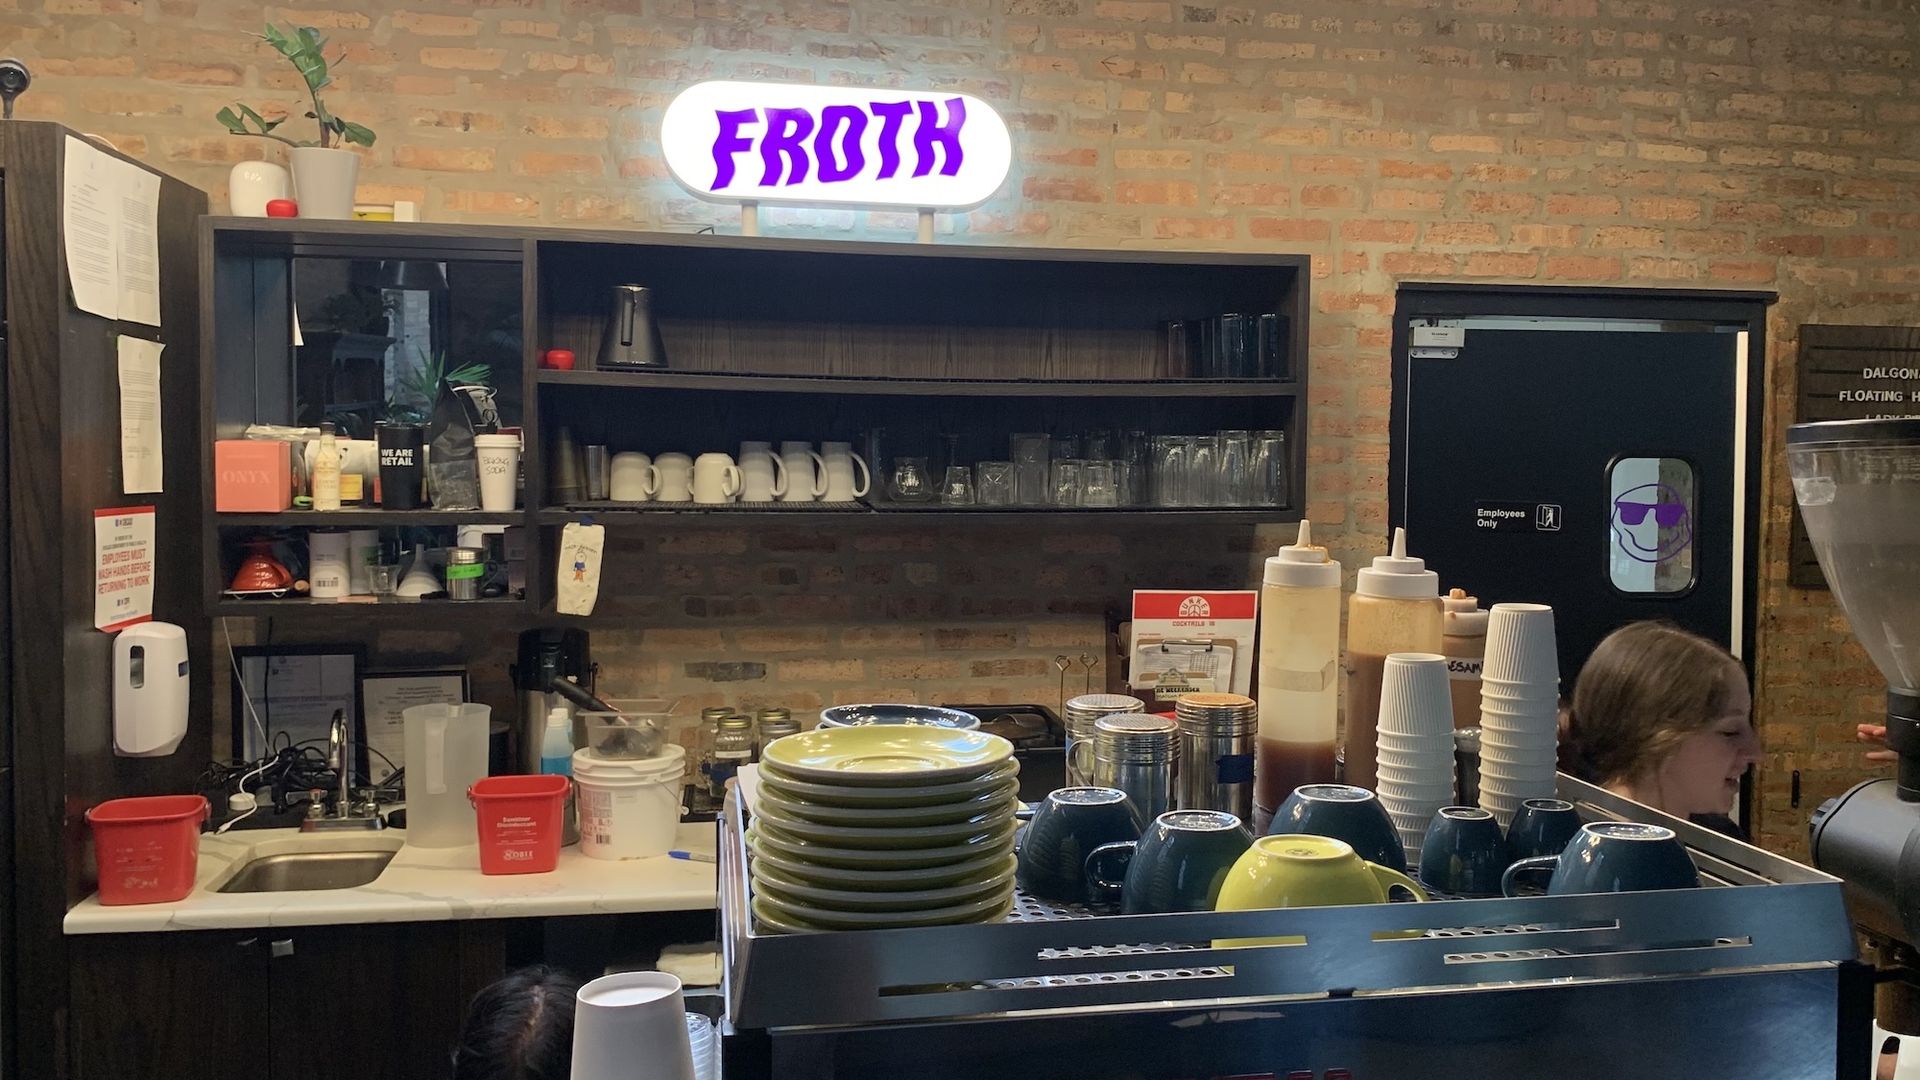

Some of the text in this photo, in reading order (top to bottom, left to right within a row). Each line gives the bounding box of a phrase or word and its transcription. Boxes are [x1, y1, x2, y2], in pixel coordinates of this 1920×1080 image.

[710, 97, 966, 191] FROTH
[1863, 367, 1920, 379] DALGON
[1839, 390, 1903, 402] FLOATING
[381, 449, 413, 457] WE ARE
[381, 458, 413, 466] RETAIL
[486, 465, 506, 475] SODA
[223, 470, 272, 483] ONYX
[1477, 508, 1525, 518] Employees
[1477, 519, 1497, 529] Only
[102, 548, 146, 565] EMPLOYEES MUST
[98, 561, 151, 580] WASH HANDS BEFORE
[98, 580, 126, 594] RETURNING
[134, 574, 150, 587] WORK
[1447, 660, 1483, 674] ESAM
